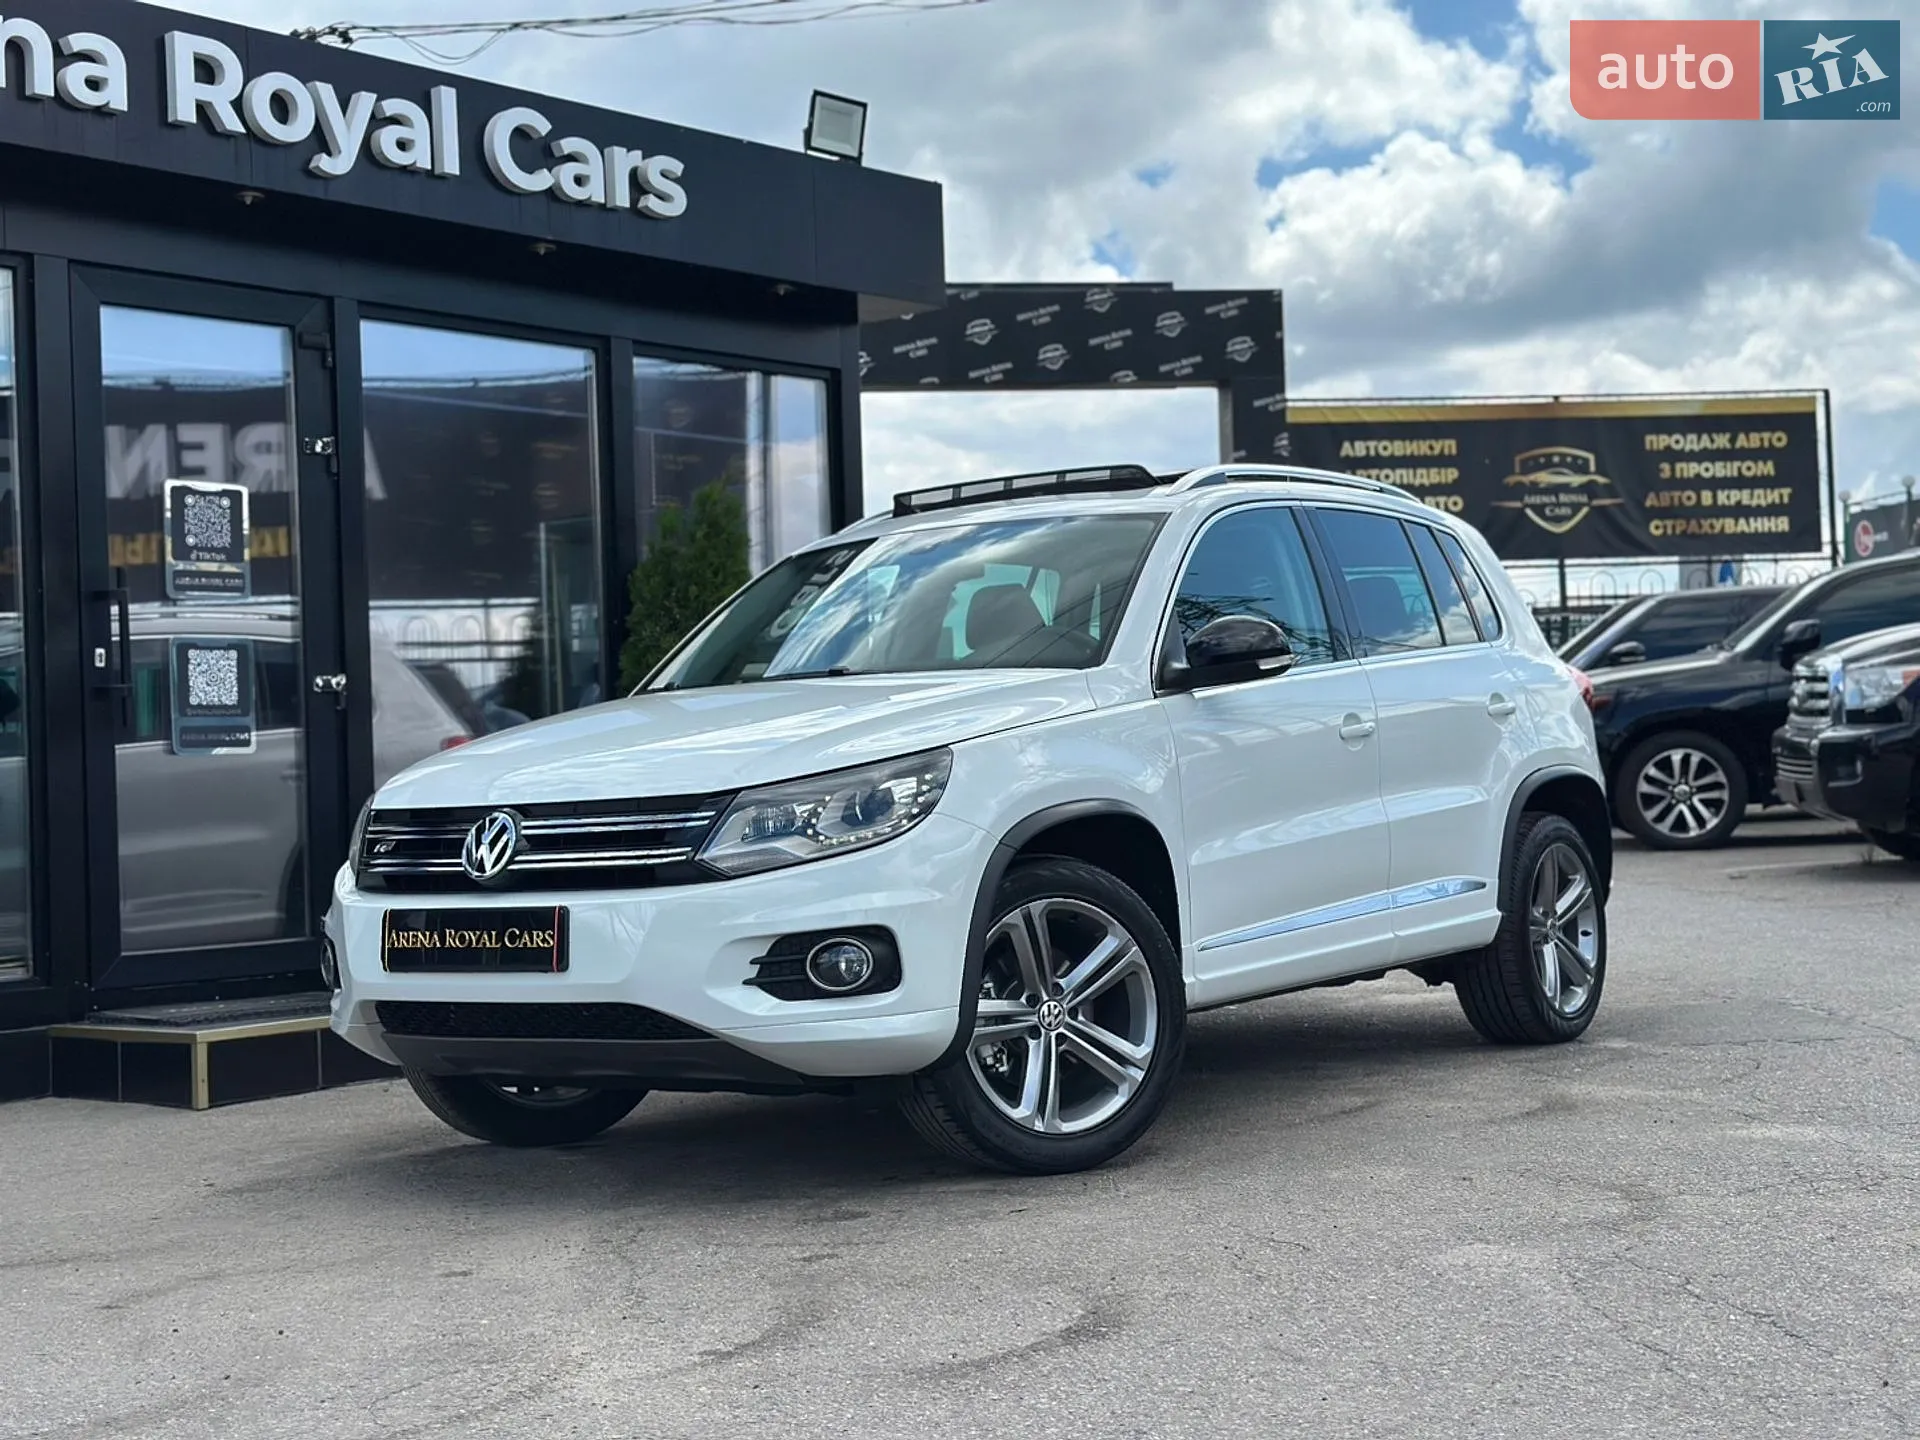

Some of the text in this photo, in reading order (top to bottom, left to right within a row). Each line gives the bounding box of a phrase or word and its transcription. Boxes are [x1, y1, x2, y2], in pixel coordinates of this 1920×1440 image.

[164, 30, 461, 178] Royal
[484, 106, 688, 219] Cars
[1340, 439, 1457, 457] АВТОВИКУП
[1645, 430, 1788, 453] ПРОДАЖ АВТО
[1346, 467, 1459, 486] ТОПІДБІР
[1674, 460, 1775, 478] ПРОБІГОМ
[1423, 495, 1464, 512] ВТО
[1645, 489, 1697, 508] АВТО
[1716, 487, 1792, 507] КРЕДИТ
[1649, 516, 1790, 536] СТРАХУВАННЯ
